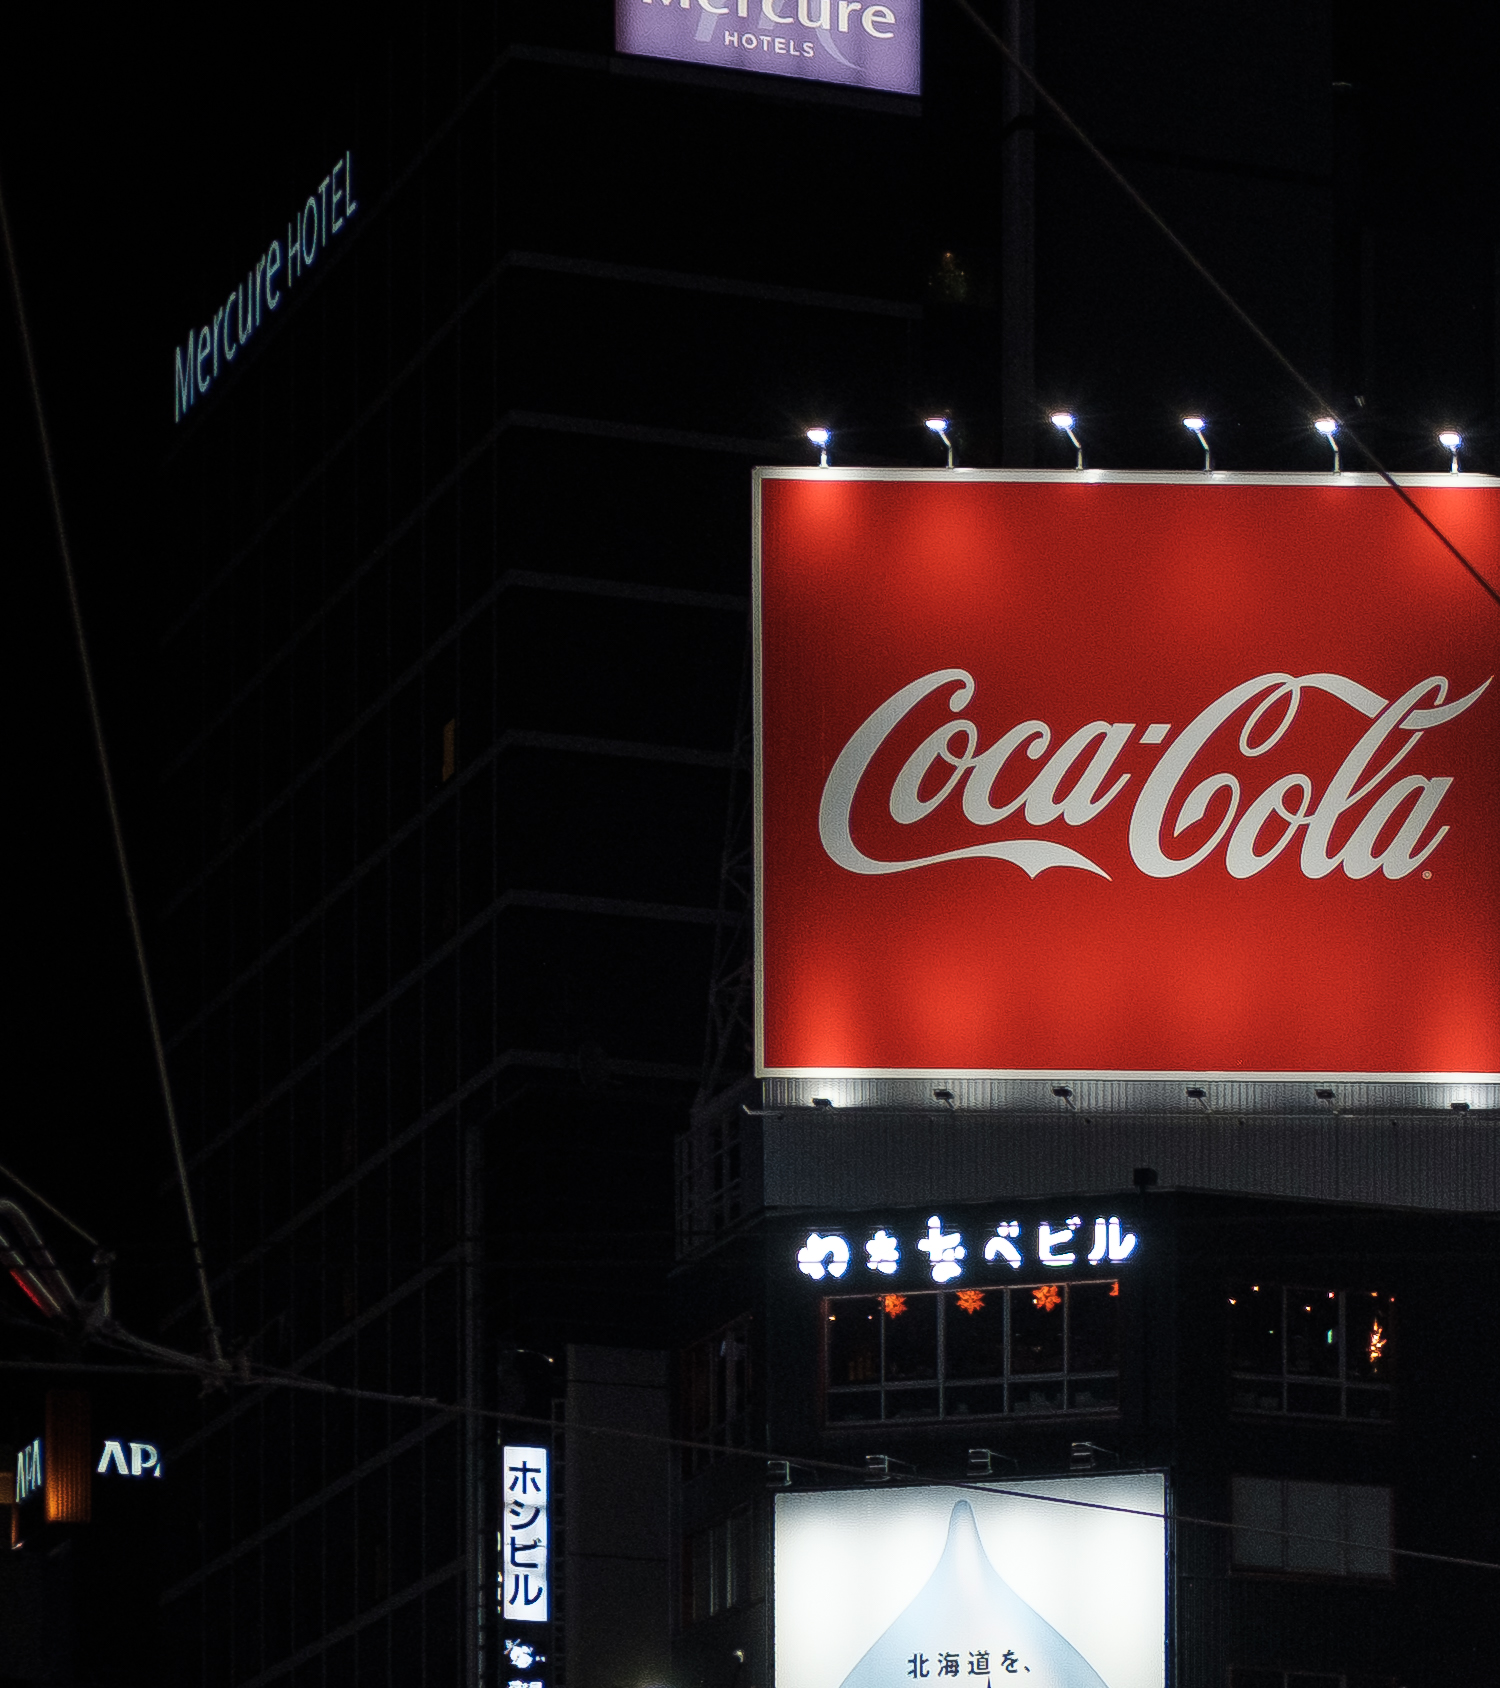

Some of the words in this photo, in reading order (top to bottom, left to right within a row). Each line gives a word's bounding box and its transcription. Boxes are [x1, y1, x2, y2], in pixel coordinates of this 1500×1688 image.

[724, 30, 814, 57] HOTELS
[173, 238, 281, 422] Mercure
[286, 150, 358, 290] HOTEL
[818, 668, 1495, 882] Coca-Cola
[97, 1441, 161, 1478] AP
[506, 1459, 544, 1607] ホシビル
[906, 1649, 1032, 1679] 北海道を、
